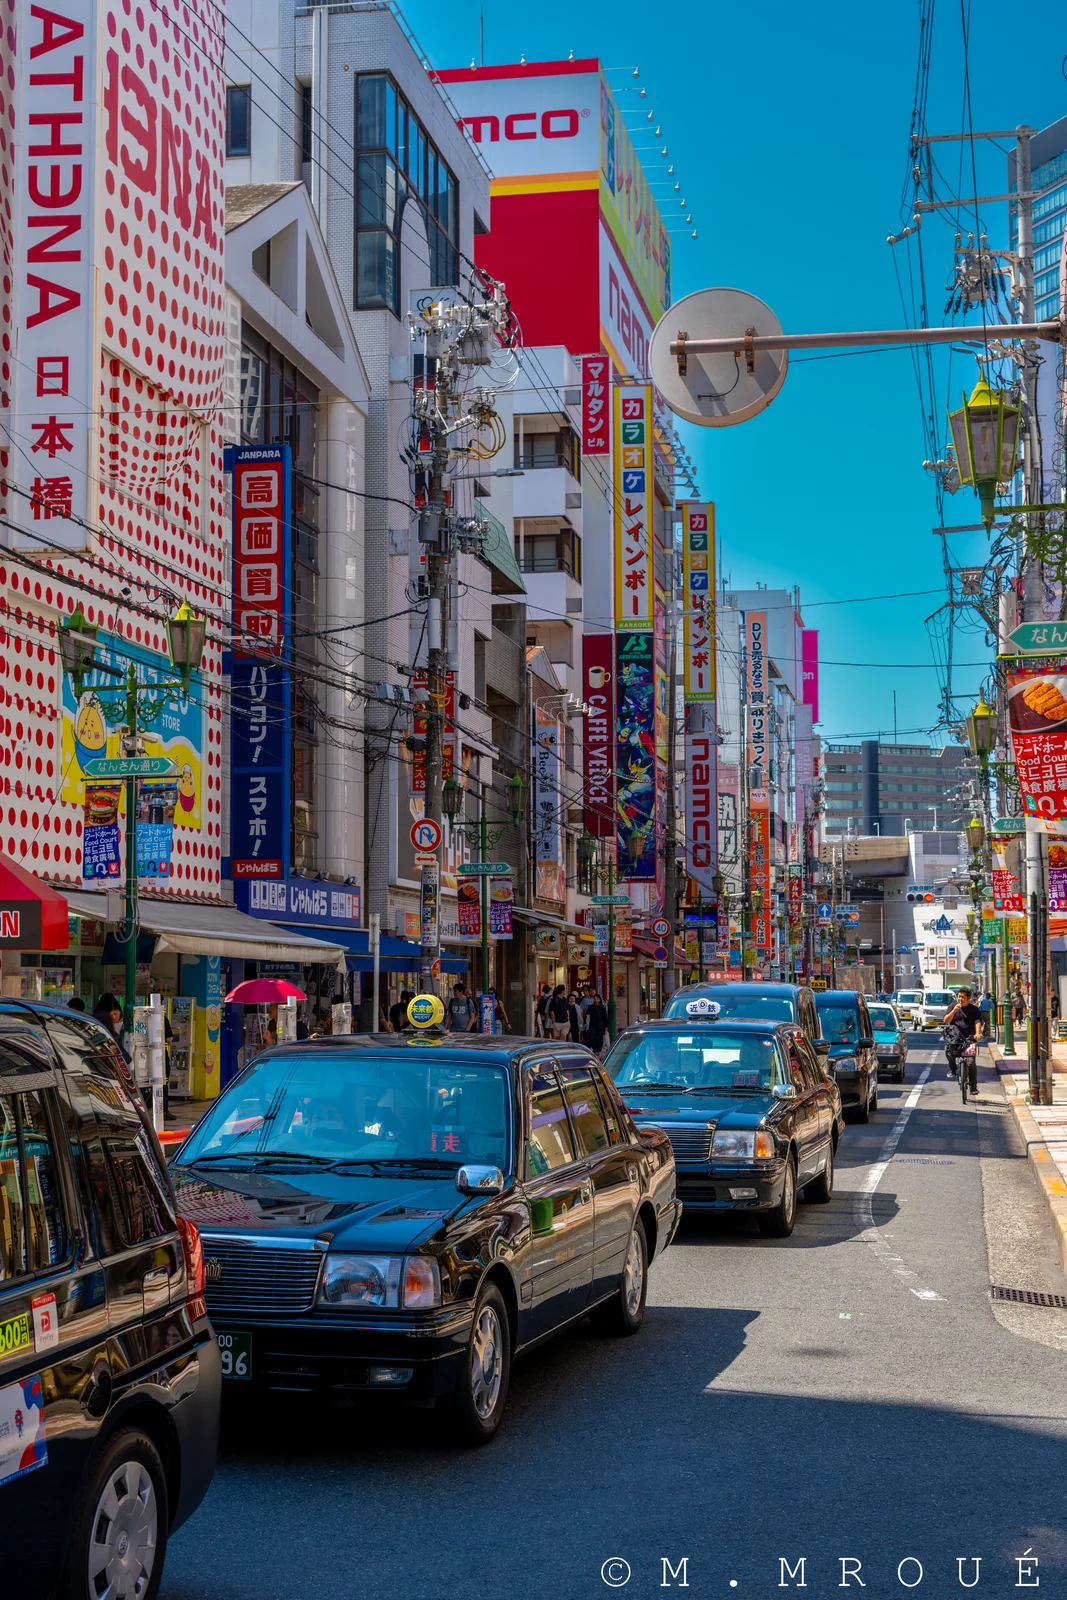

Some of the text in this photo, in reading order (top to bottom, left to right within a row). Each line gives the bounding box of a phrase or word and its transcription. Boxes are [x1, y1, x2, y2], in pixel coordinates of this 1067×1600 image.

[587, 362, 605, 448] マルタン ビル
[30, 355, 74, 522] 日本橋
[237, 450, 281, 459] JANPARA
[240, 470, 278, 648] 高価買取
[588, 695, 608, 742] CAFFÈ
[1019, 735, 1058, 745] コミュニティー
[97, 760, 161, 772] なんさん通り
[1017, 756, 1040, 766] Food
[691, 738, 710, 868] namco
[85, 829, 118, 840] フードホール
[137, 827, 173, 837] フードホール
[0, 911, 19, 937] N
[656, 923, 666, 932] 40
[690, 1004, 716, 1013] 近鉄
[734, 1073, 758, 1086] 回送
[214, 1334, 233, 1348] 00
[221, 1350, 247, 1375] 96
